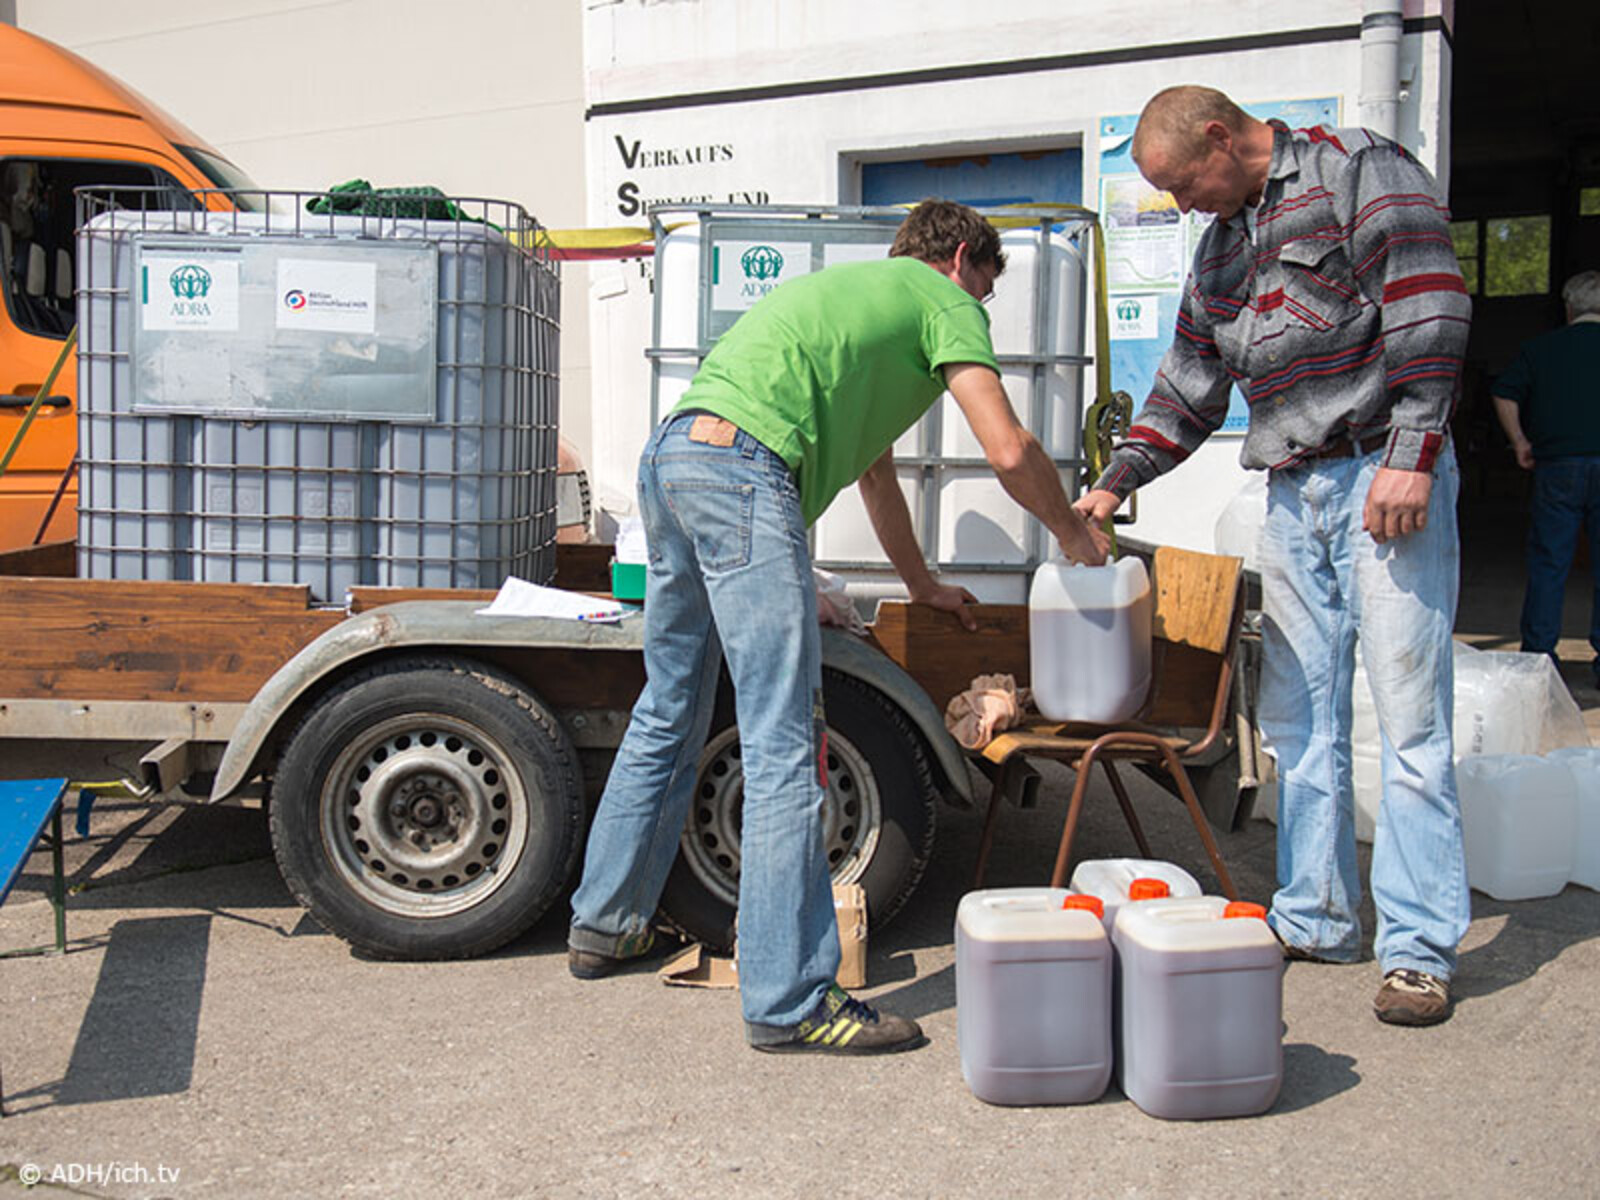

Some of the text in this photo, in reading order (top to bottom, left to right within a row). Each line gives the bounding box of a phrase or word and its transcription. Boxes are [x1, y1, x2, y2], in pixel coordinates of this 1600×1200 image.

[615, 135, 733, 169] VERKAUFS
[741, 283, 778, 297] ADR
[170, 301, 211, 316] ADRA
